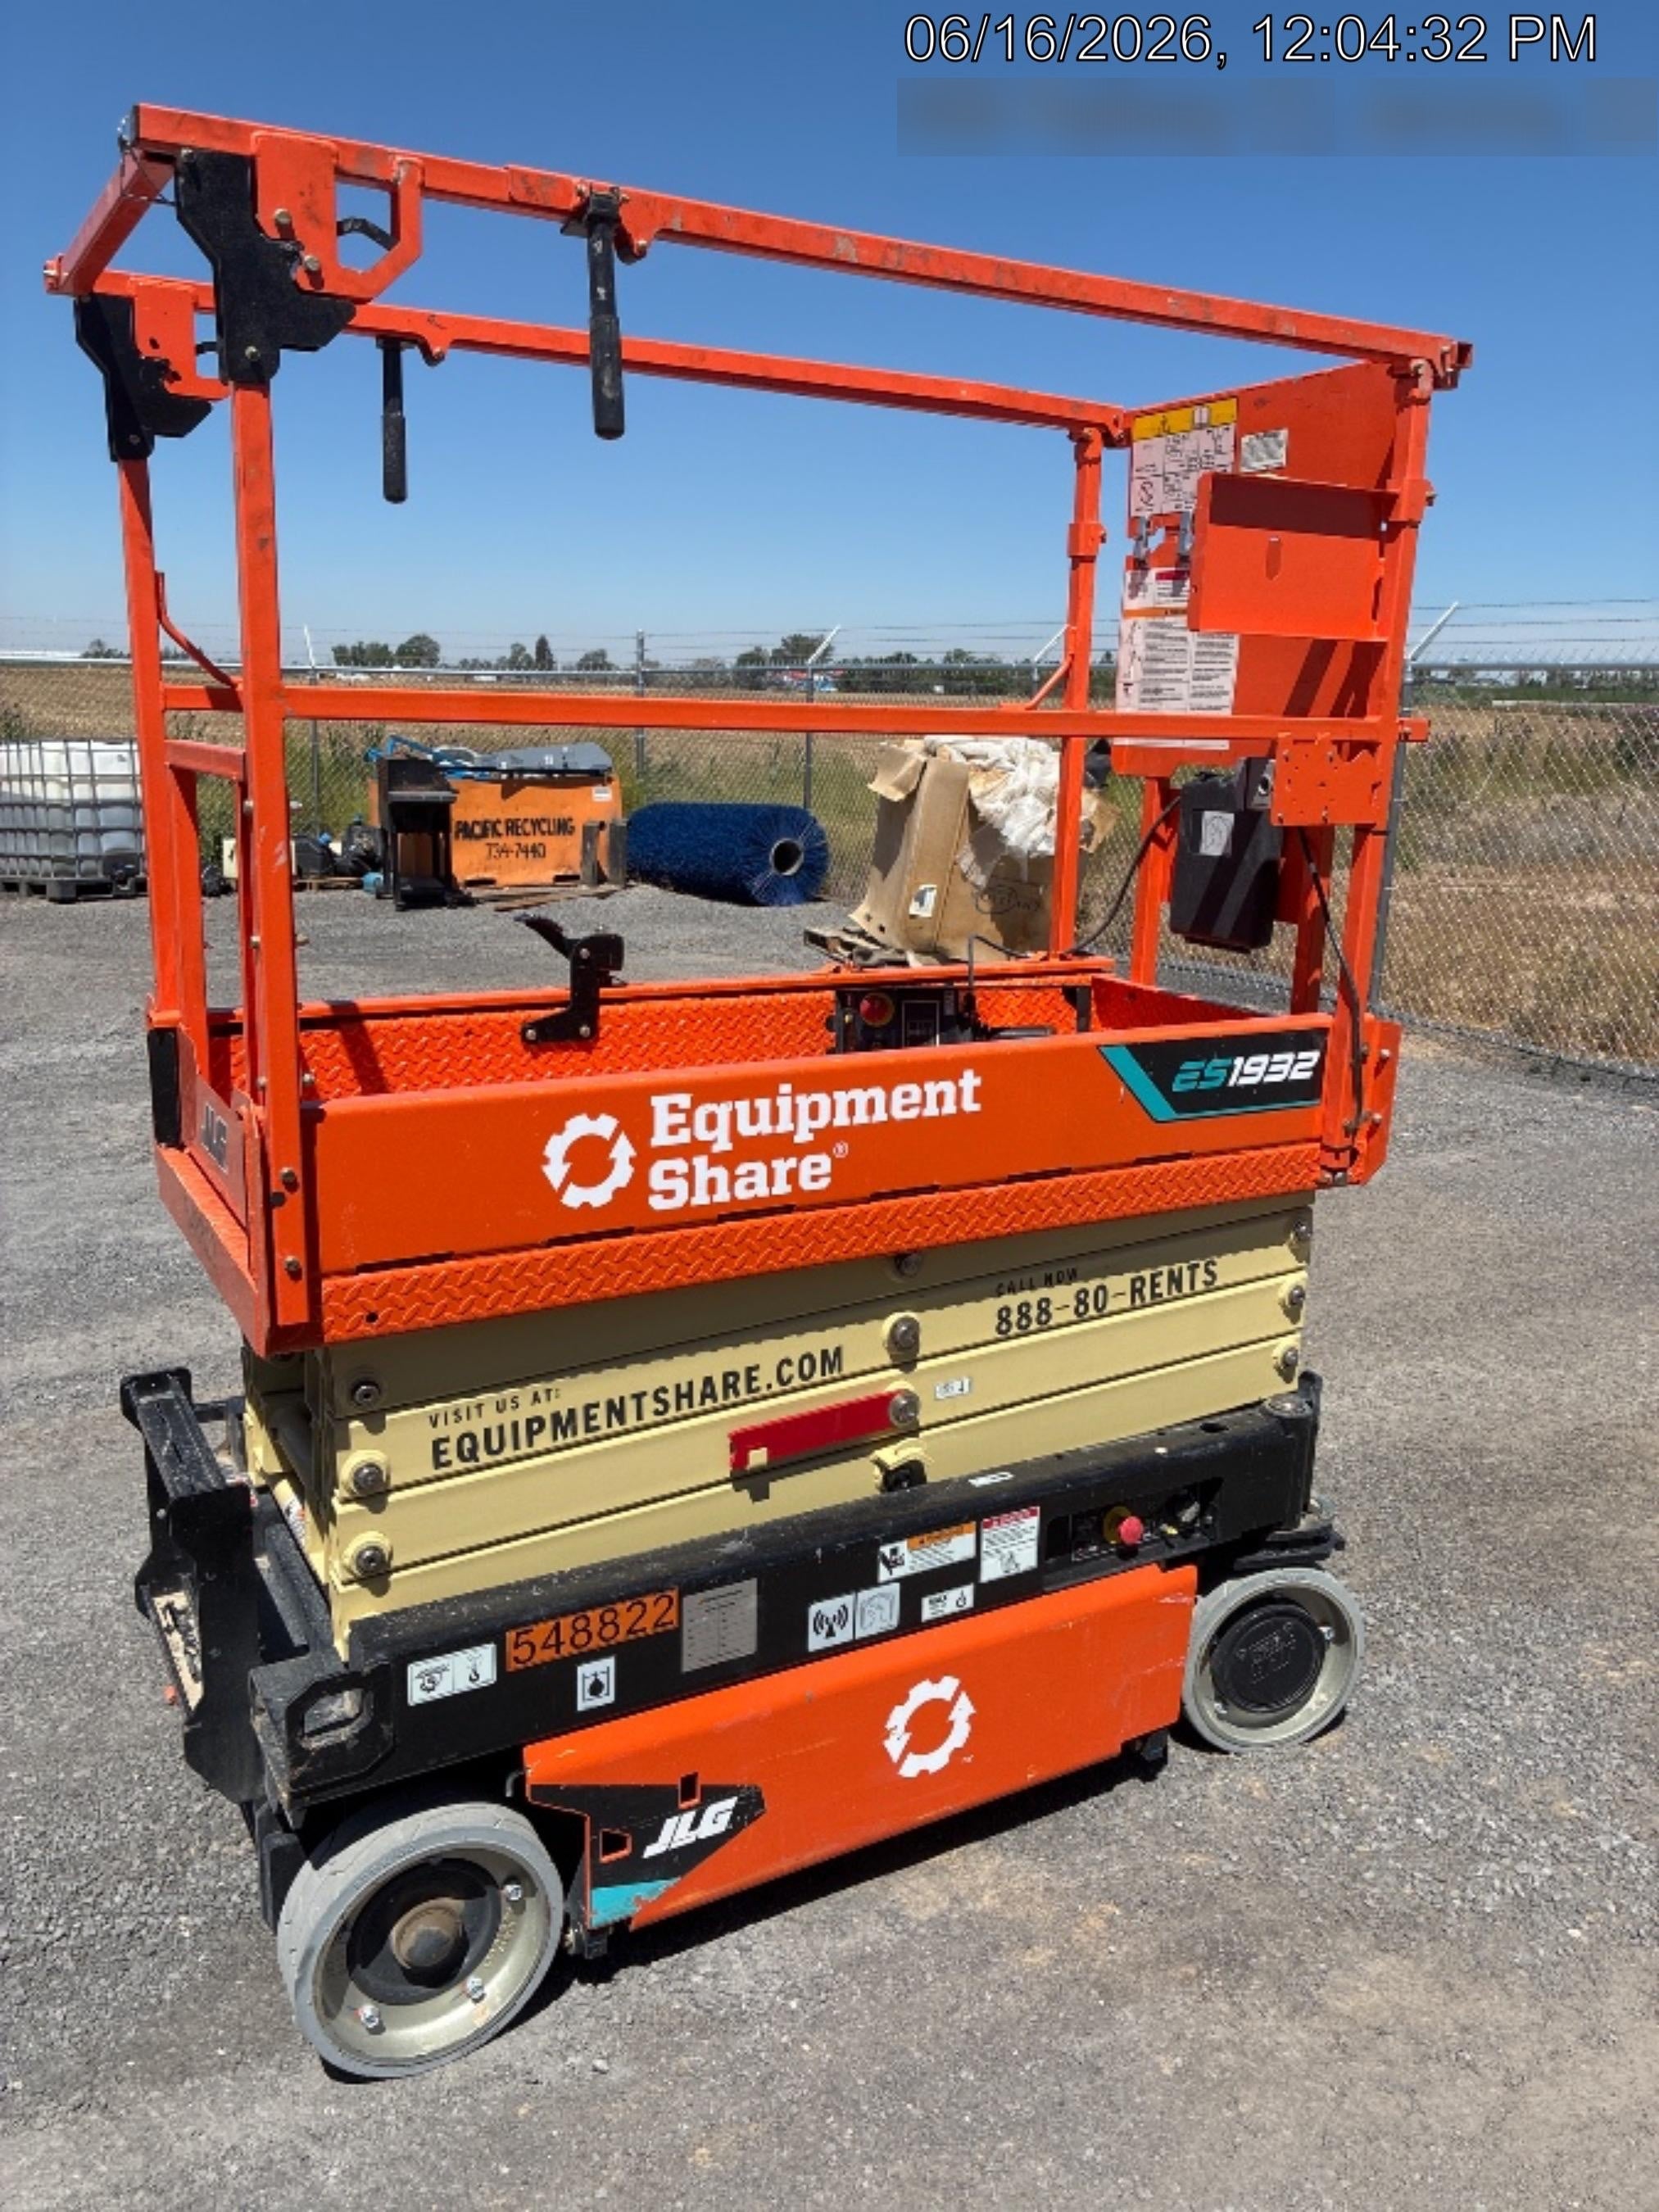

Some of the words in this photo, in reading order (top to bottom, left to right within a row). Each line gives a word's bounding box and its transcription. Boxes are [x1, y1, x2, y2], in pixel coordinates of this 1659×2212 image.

[455, 819, 502, 841] PACIFIC
[505, 817, 575, 836] RECYCLING
[1172, 1049, 1321, 1093] ES1932
[650, 1068, 982, 1154] Equipment
[995, 1277, 1036, 1296] CALL
[1043, 1267, 1078, 1286] NOW
[995, 1259, 1218, 1335] 888-80-RENTS
[428, 1403, 485, 1428] VISIT
[496, 1396, 519, 1414] US
[530, 1389, 560, 1406] AT:
[431, 1345, 844, 1471] EQUIPMENTSHARE.COM
[512, 1593, 675, 1665] 548822
[641, 1796, 738, 1859] JLG
